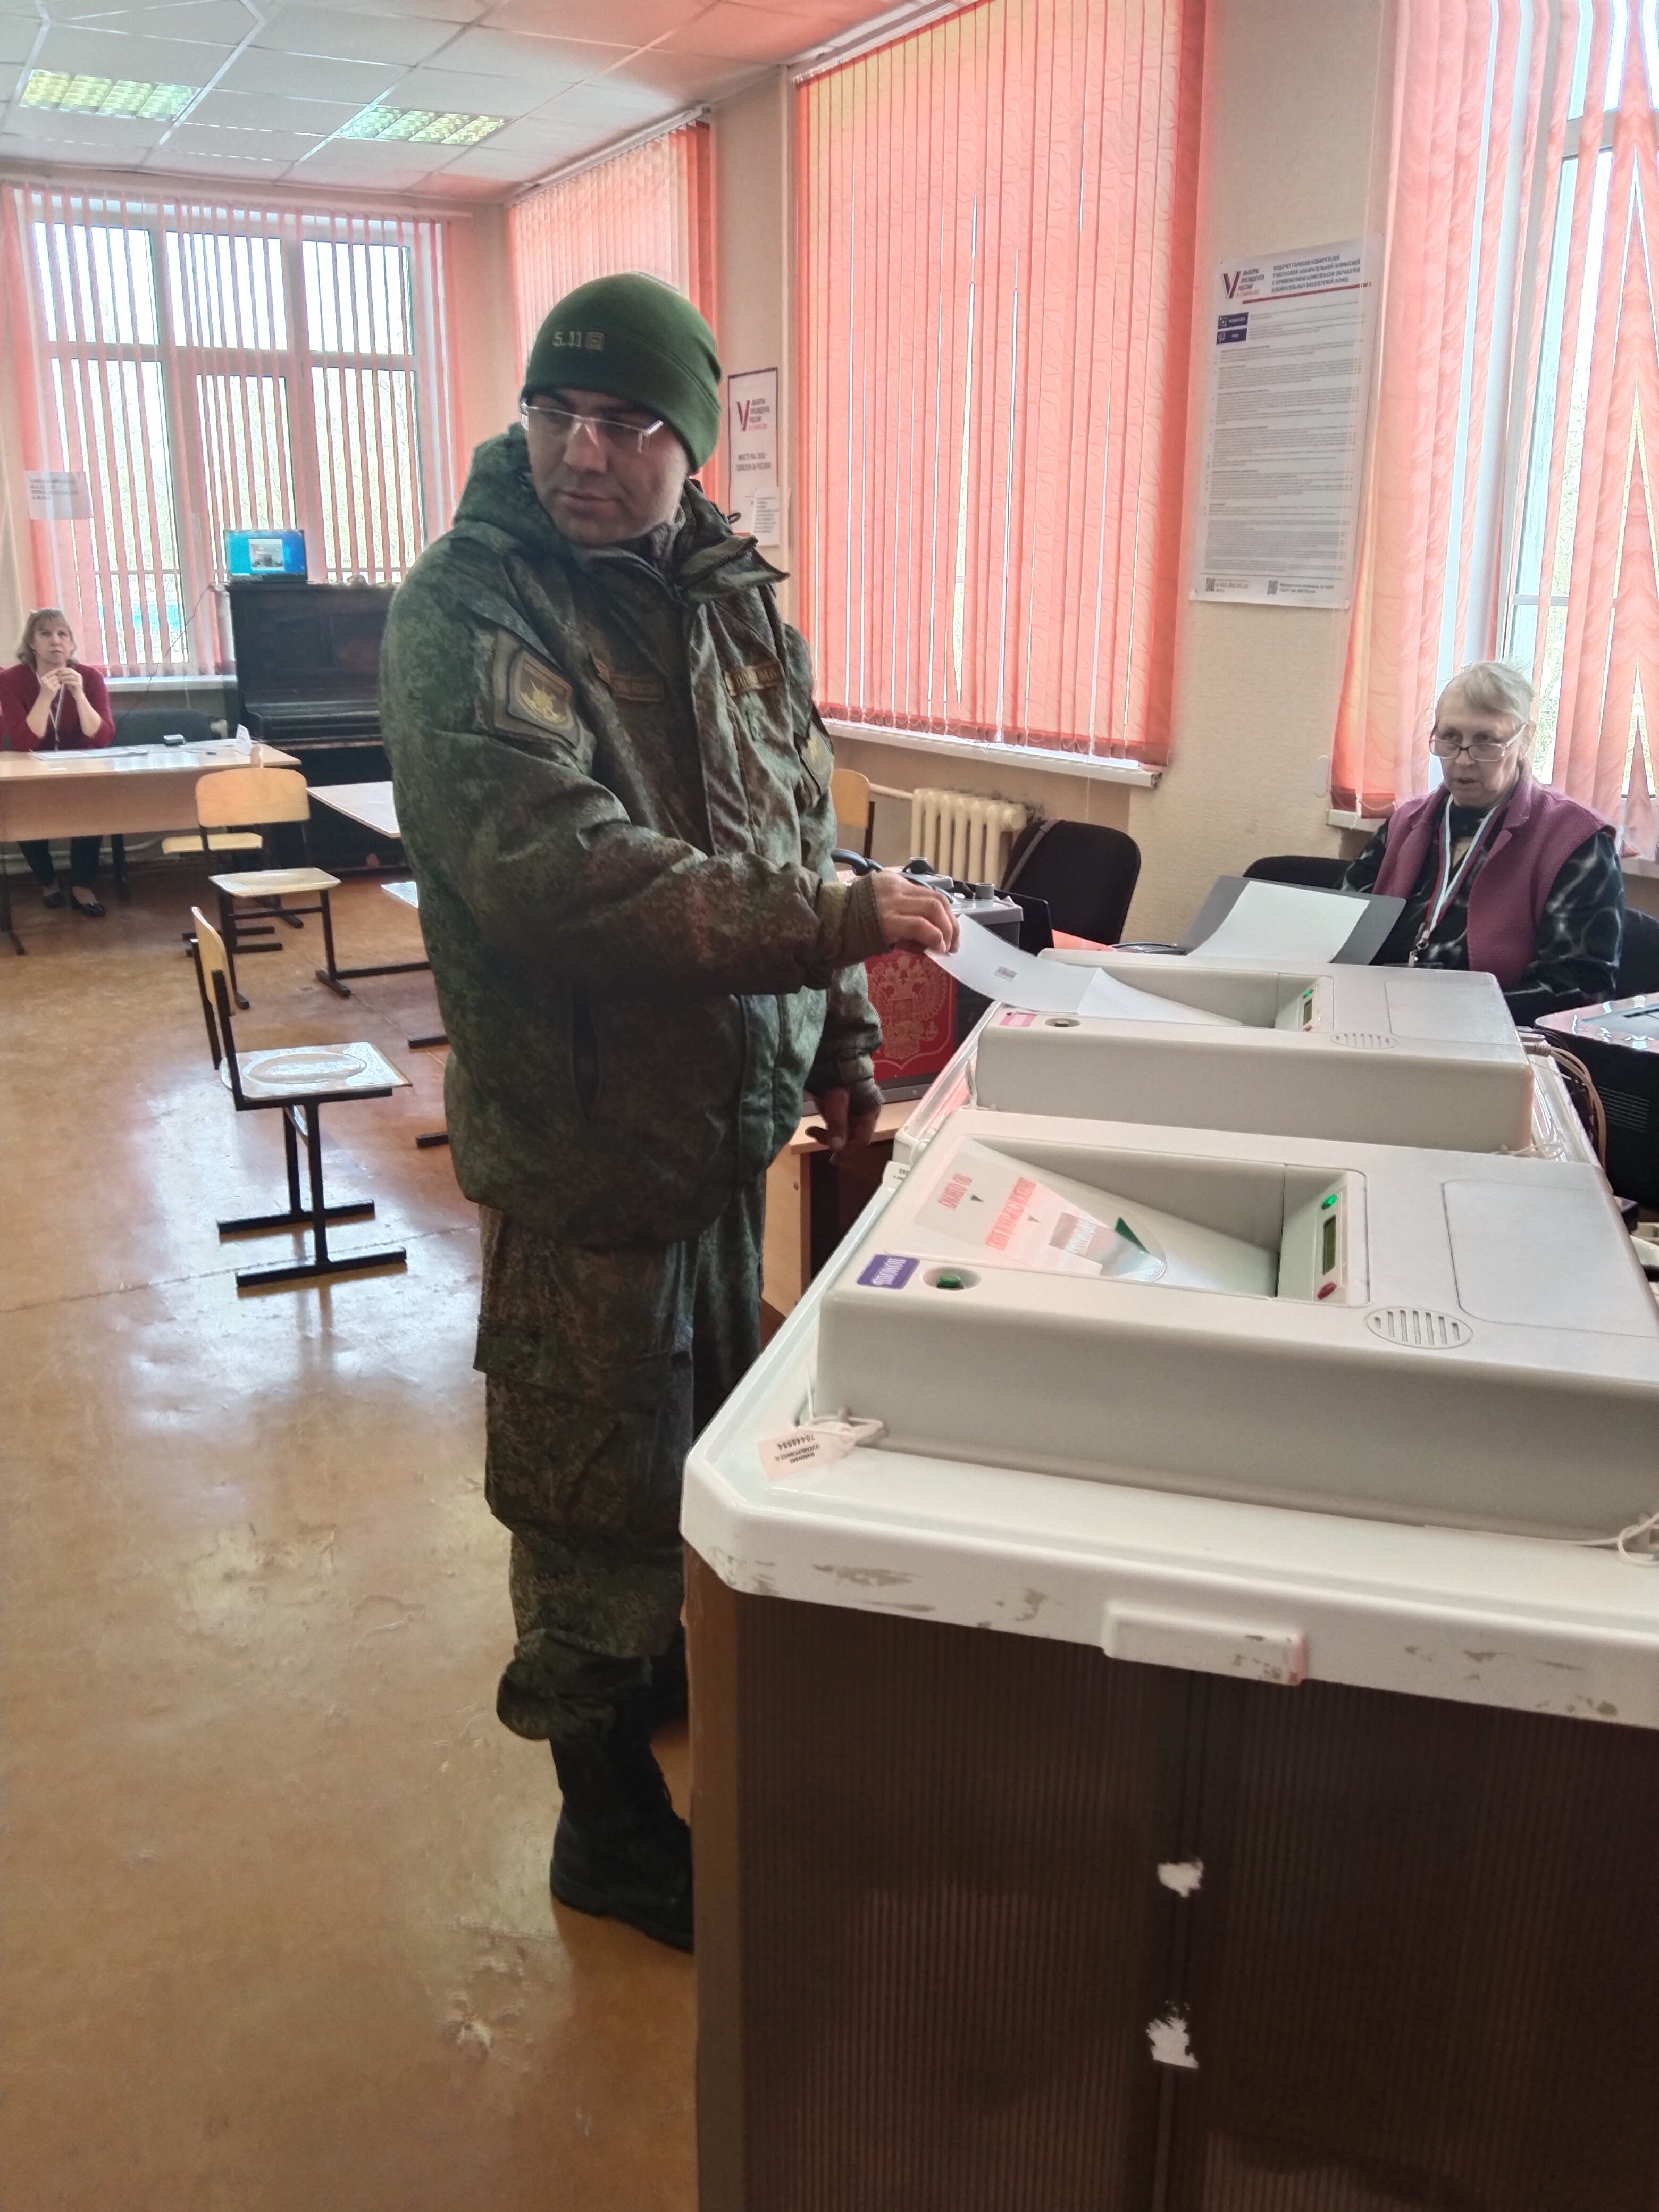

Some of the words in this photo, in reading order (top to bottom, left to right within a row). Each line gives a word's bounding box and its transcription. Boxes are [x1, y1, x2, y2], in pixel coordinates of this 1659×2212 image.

[1299, 263, 1334, 274] ИЗБИРАТЕЛЬНОЙ
[1334, 258, 1360, 269] КОМИССИЕЙ
[1311, 254, 1340, 265] ИЗБИРАТЕЛЕЙ
[1306, 271, 1335, 281] КОМПЛЕКСОВ
[552, 330, 582, 347] 5.11
